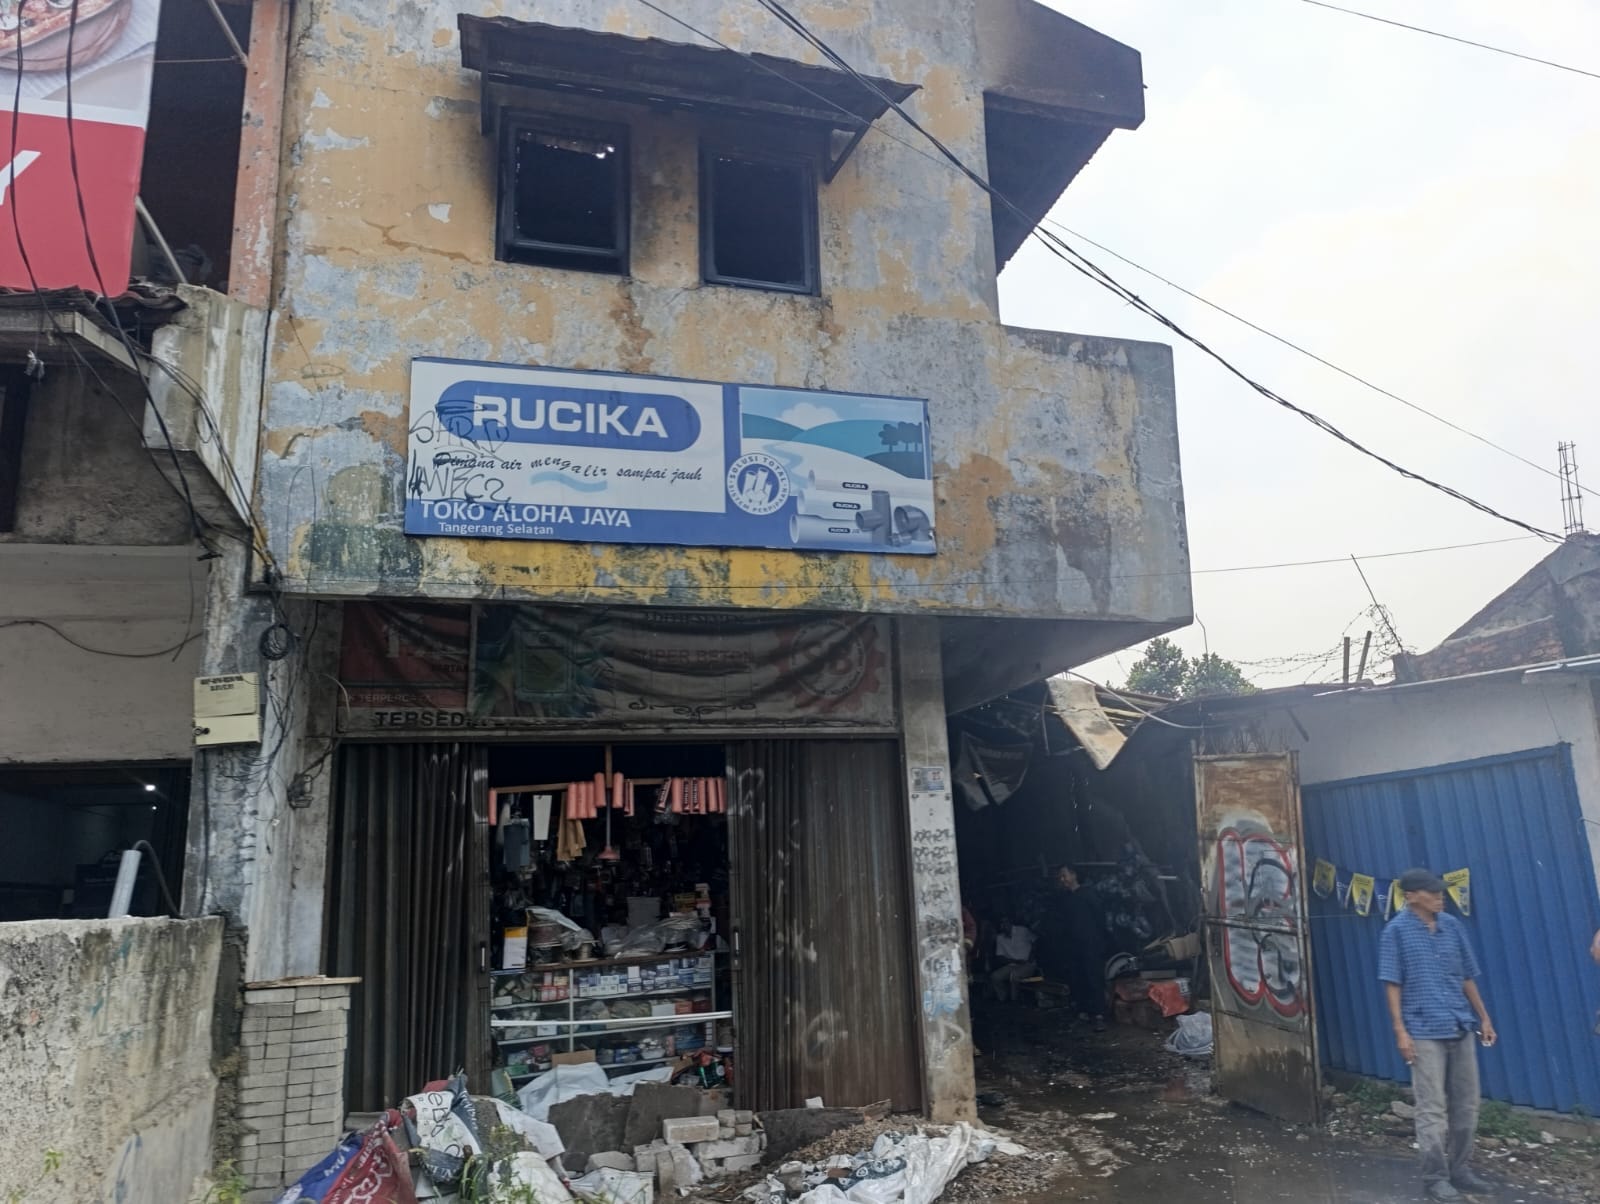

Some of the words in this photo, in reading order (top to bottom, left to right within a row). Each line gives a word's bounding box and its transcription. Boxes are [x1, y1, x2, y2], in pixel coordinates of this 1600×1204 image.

[473, 394, 669, 438] RUCIKA
[501, 459, 522, 470] air
[530, 456, 607, 477] mengalir
[616, 467, 667, 482] sampai
[670, 466, 702, 484] jauh
[729, 455, 759, 480] SOLUSI
[762, 456, 787, 482] TOTAL
[420, 500, 485, 521] TOKO
[492, 503, 574, 525] ALOHA
[581, 507, 632, 528] JAYA
[438, 521, 504, 536] Tangerang
[506, 523, 554, 536] Selatan
